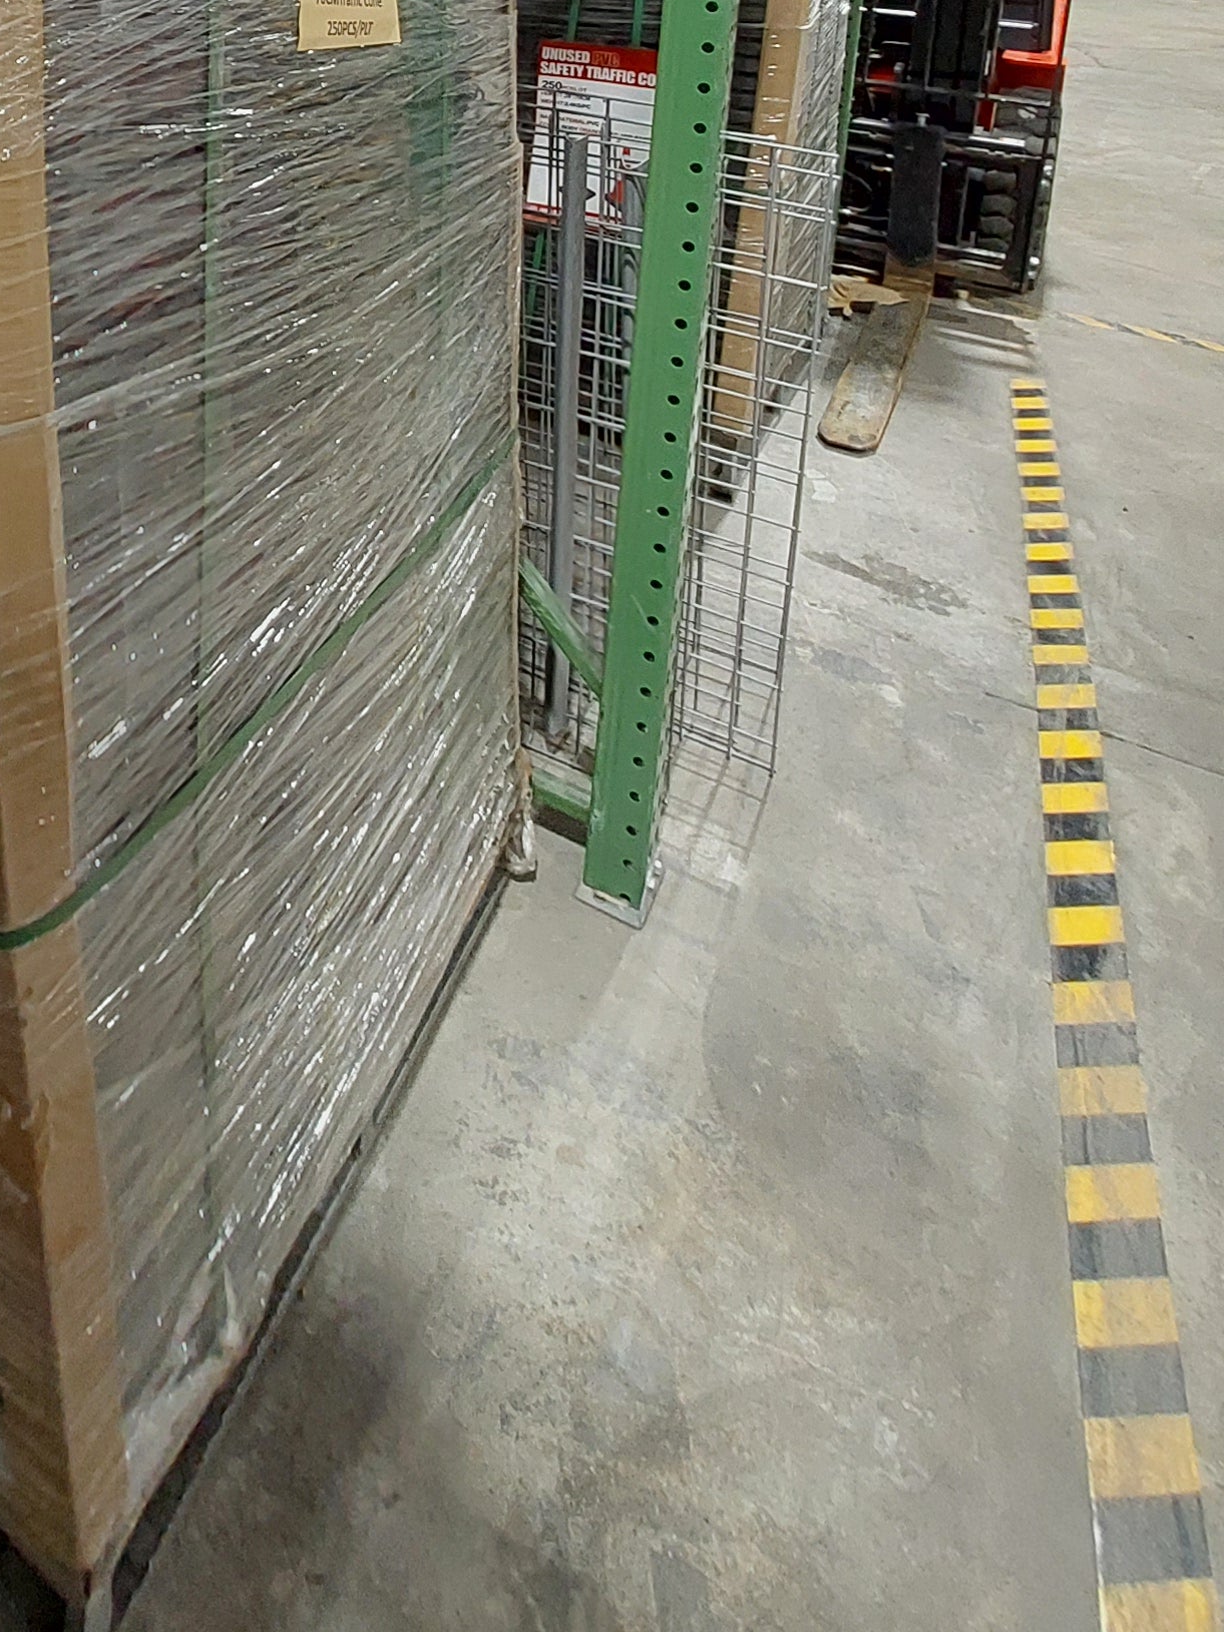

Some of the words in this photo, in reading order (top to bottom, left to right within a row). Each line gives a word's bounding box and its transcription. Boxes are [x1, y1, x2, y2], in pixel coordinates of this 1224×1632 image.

[542, 46, 590, 63] UNUSED
[540, 61, 584, 77] SAFETY
[586, 65, 636, 84] TRAFFIC
[541, 80, 562, 90] 250
